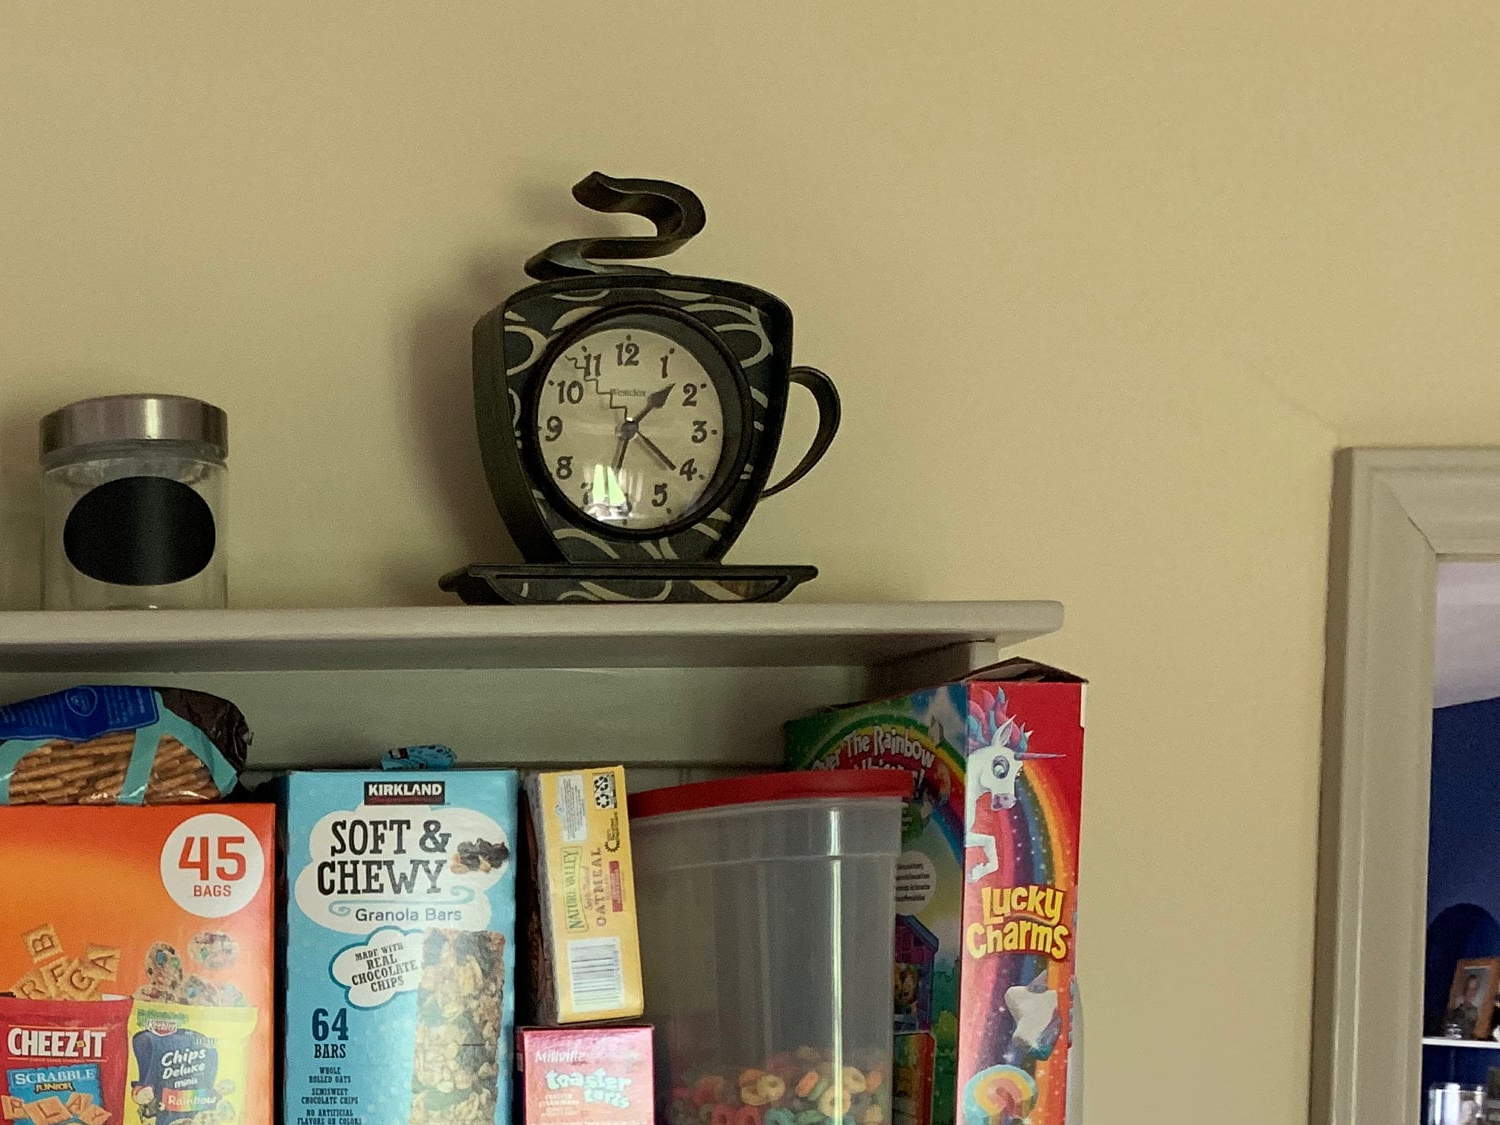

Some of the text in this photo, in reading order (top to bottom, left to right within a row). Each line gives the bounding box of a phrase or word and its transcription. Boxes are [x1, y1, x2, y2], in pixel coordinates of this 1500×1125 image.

[584, 353, 602, 377] 11
[615, 343, 640, 366] 12
[660, 355, 669, 379] 1
[558, 380, 584, 405] 10
[682, 383, 698, 407] 2
[545, 416, 563, 442] 9
[691, 420, 708, 444] 3
[556, 456, 574, 480] 8
[680, 458, 698, 481] 4
[651, 483, 668, 508] 5
[842, 725, 936, 769] The Rainbow
[368, 783, 442, 796] KIRKLAND
[330, 819, 452, 857] SOFT &
[178, 836, 247, 881] 45
[316, 859, 448, 896] CHEWY
[590, 847, 607, 927] OATMEAL
[193, 884, 232, 897] BAGS
[355, 906, 462, 922] Granola Bars
[980, 885, 1065, 927] Lucky
[355, 942, 404, 961] MADE WITH
[965, 920, 1072, 961] Charms
[351, 959, 419, 987] CHOCOLATE
[366, 953, 398, 970] REAL
[370, 975, 405, 993] CHIPS
[311, 1008, 349, 1041] 64
[161, 1049, 207, 1067] Chips
[313, 1043, 347, 1059] BARS
[14, 1068, 96, 1085] SCRABBLE
[162, 1062, 206, 1080] Deluxe
[308, 1075, 351, 1083] ROLLED OATS
[319, 1066, 341, 1075] WHOLE
[545, 1067, 632, 1092] toaster
[34, 1081, 74, 1093] JUNIOR
[311, 1087, 348, 1096] SEMISWEET
[583, 1088, 629, 1109] tarts
[167, 1094, 217, 1107] Rainbow
[301, 1096, 359, 1105] CHOCOLATE CHIPS
[297, 1117, 362, 1125] FLAVORS OR COLORS
[306, 1108, 353, 1117] NO ARTIFICIAL
